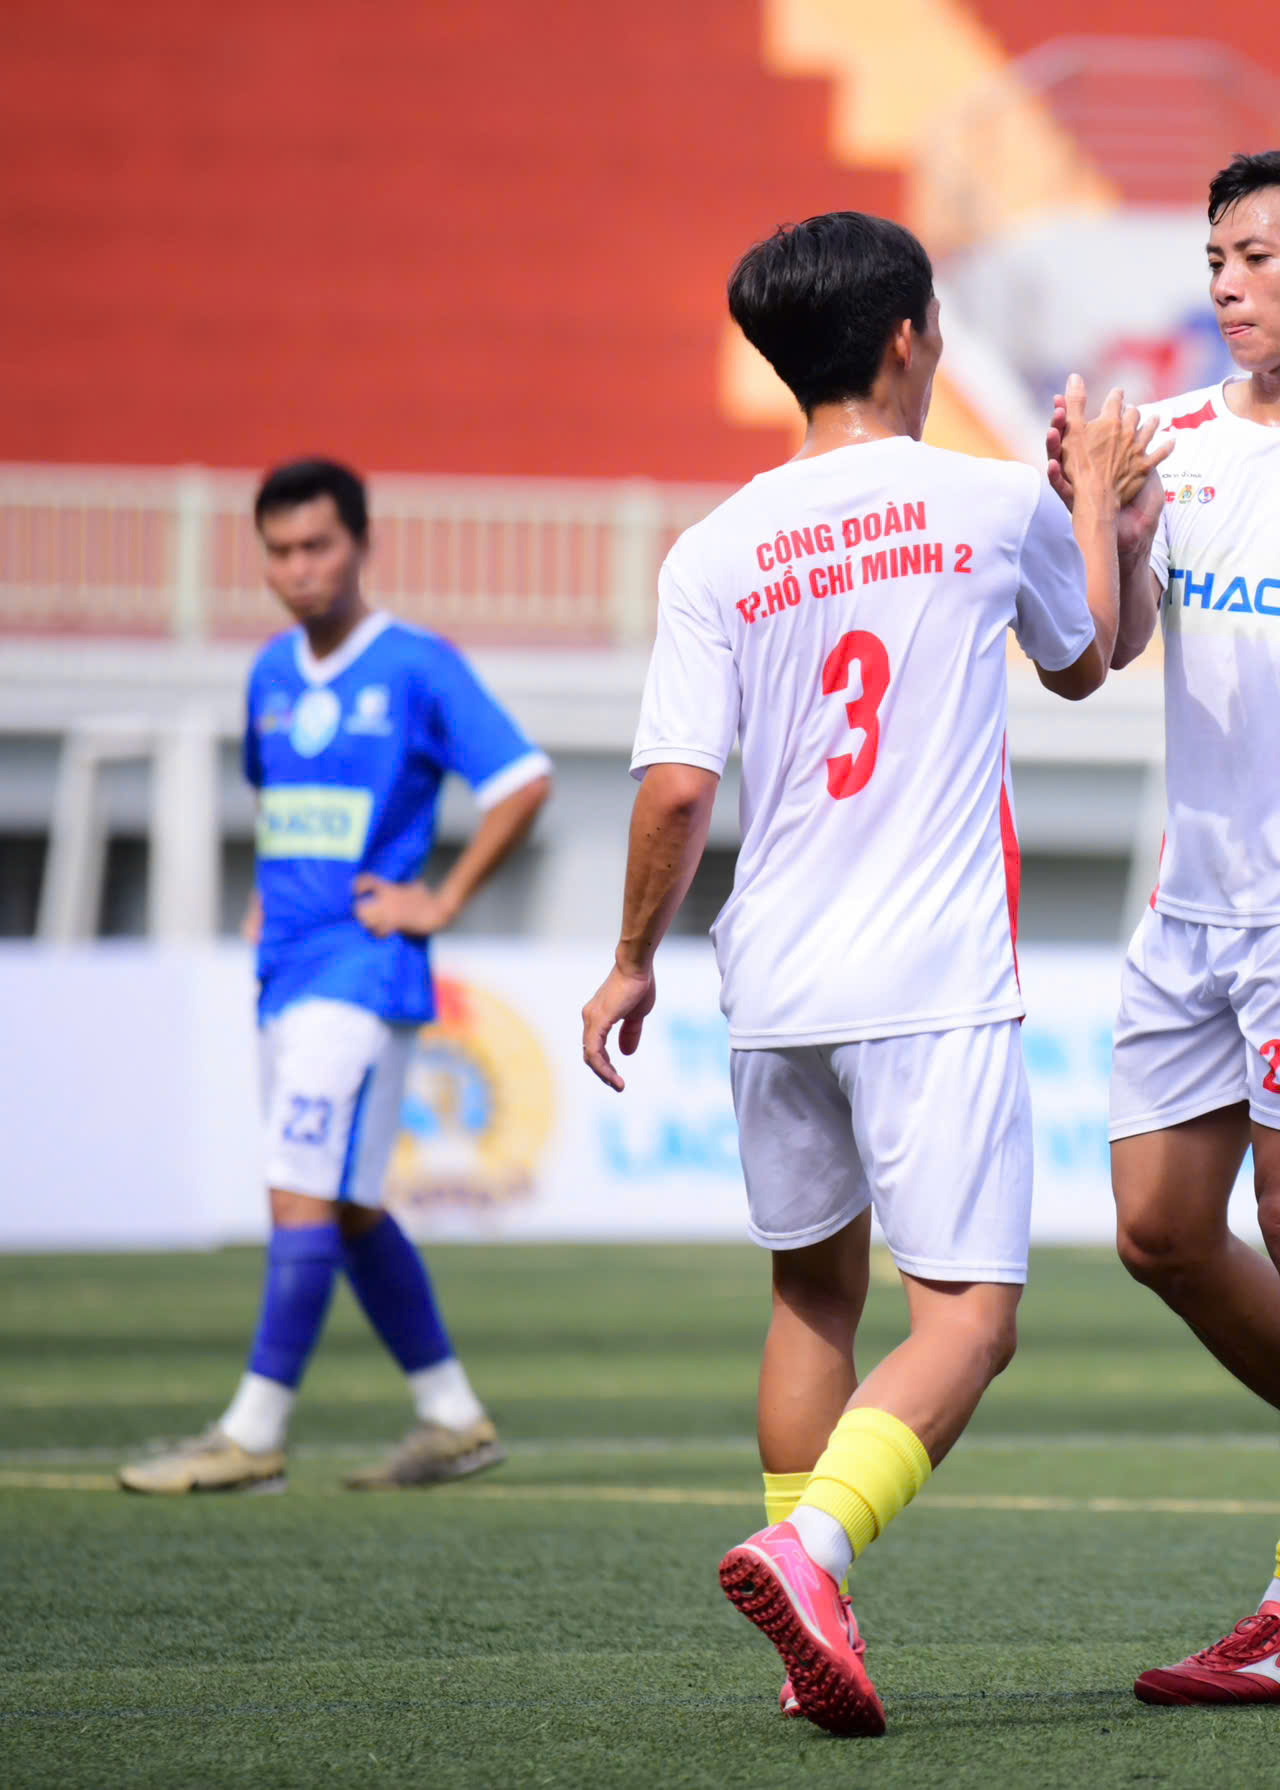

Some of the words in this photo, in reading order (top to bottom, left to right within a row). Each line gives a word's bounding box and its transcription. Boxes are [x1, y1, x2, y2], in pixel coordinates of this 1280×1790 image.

[756, 531, 835, 572] CÔNG
[842, 501, 927, 549] ĐOÀN
[809, 556, 854, 599] CHÍ
[861, 543, 943, 585] MINH
[954, 544, 973, 574] 2
[822, 630, 890, 800] 3
[283, 1095, 335, 1147] 23
